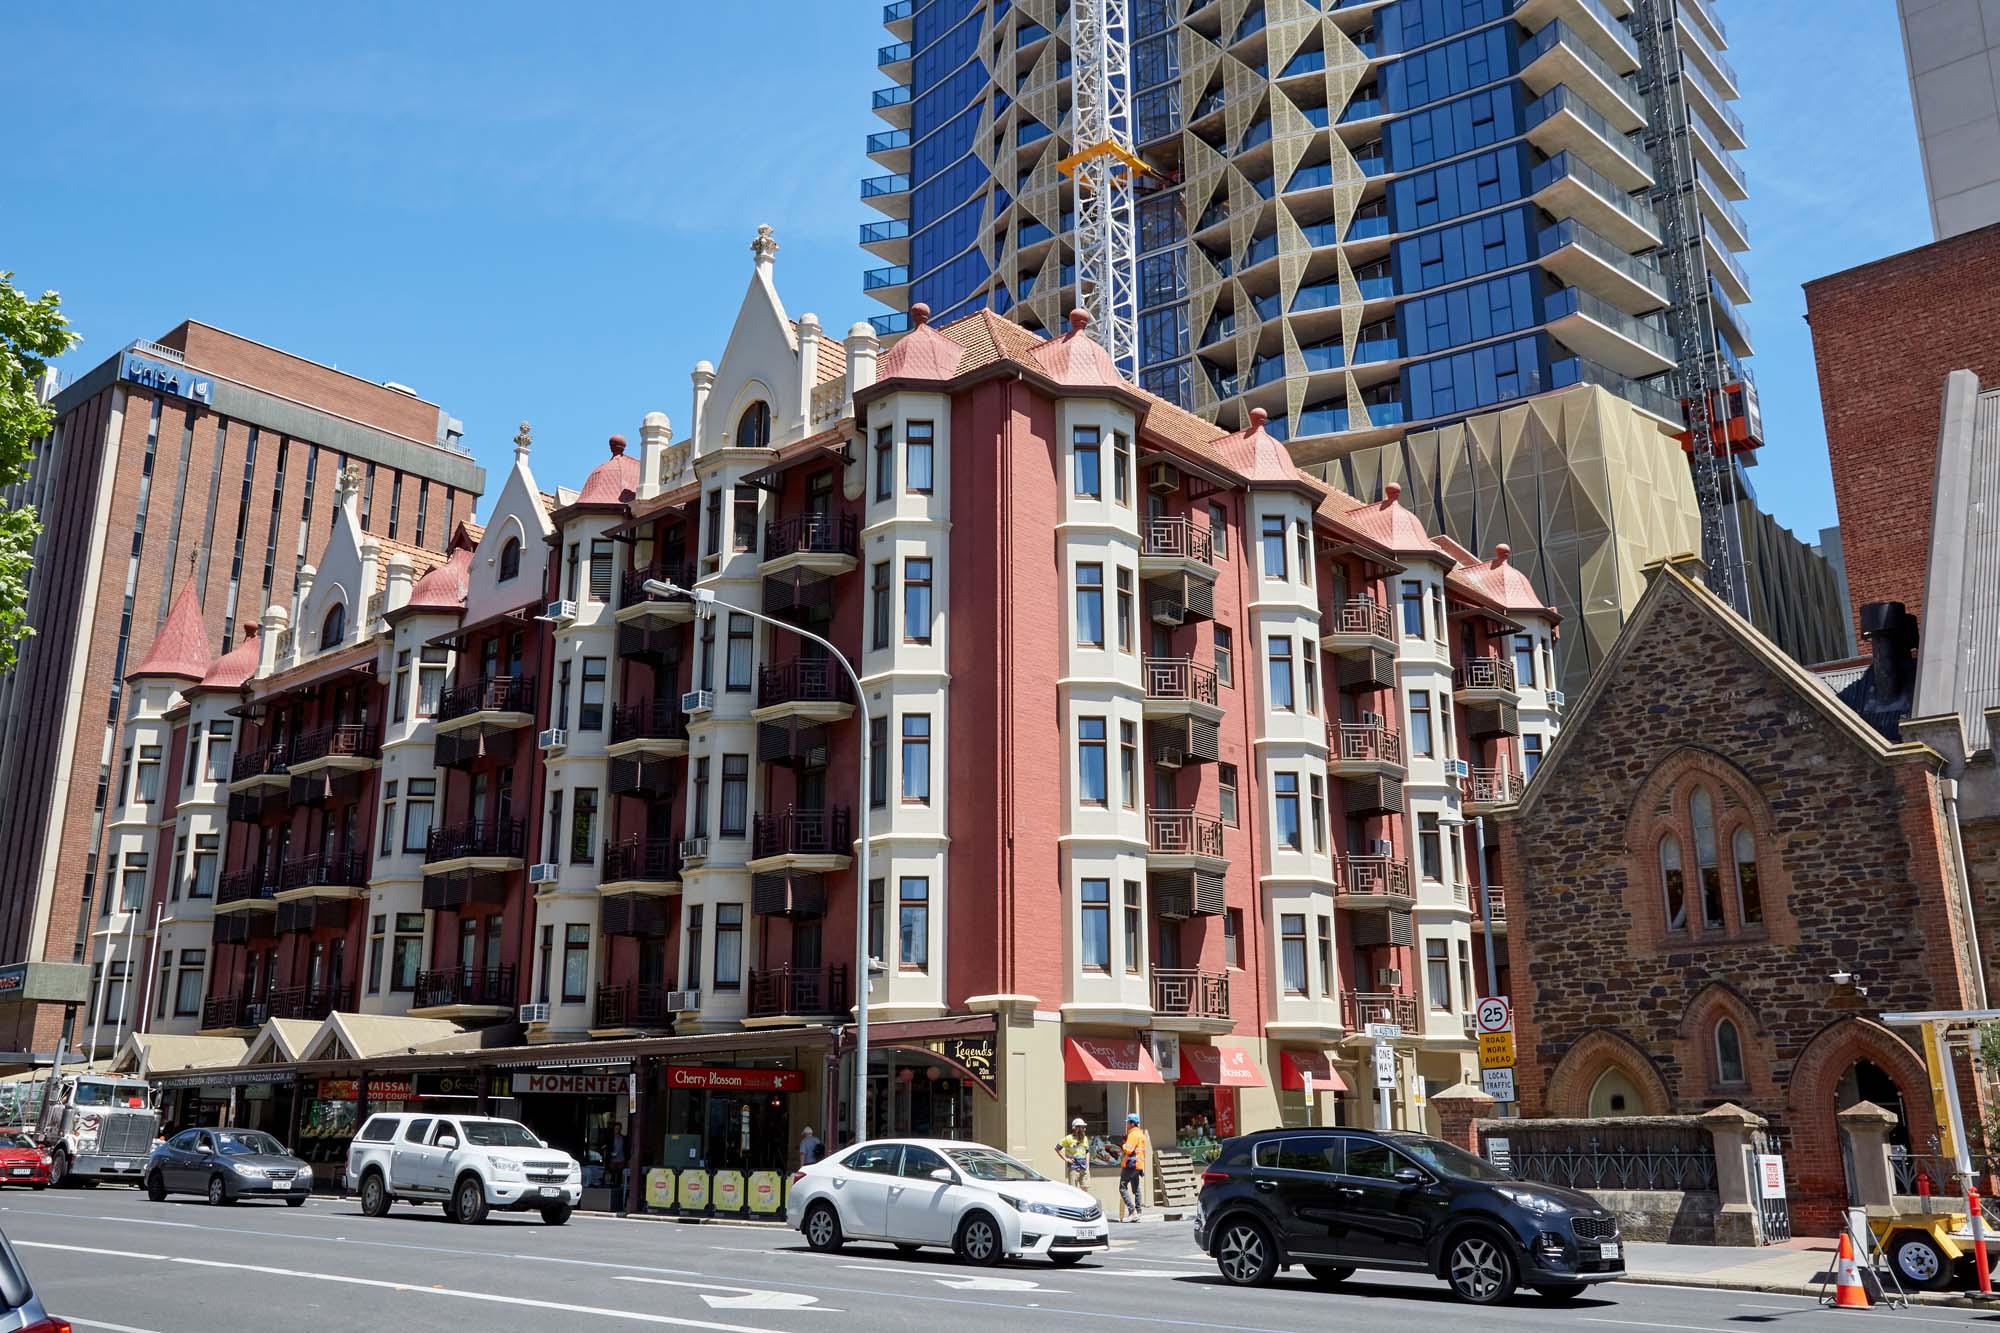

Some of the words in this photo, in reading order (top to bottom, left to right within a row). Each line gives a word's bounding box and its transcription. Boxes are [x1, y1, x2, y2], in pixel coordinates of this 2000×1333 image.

[1483, 1007, 1503, 1022] 25
[954, 1040, 994, 1068] Legends
[1082, 1041, 1116, 1057] Cherry
[1379, 1049, 1391, 1060] ONE
[1486, 1046, 1507, 1054] WORK
[1484, 1055, 1511, 1064] AHEAD
[1379, 1062, 1392, 1073] WAY
[675, 1070, 707, 1087] Cherry
[709, 1071, 742, 1086] Blossom
[1488, 1071, 1508, 1080] LOCAL
[528, 1075, 630, 1093] MOMENTEA
[1486, 1081, 1512, 1089] TRAFFIC
[367, 1092, 383, 1100] OOD
[385, 1092, 412, 1100] COURT
